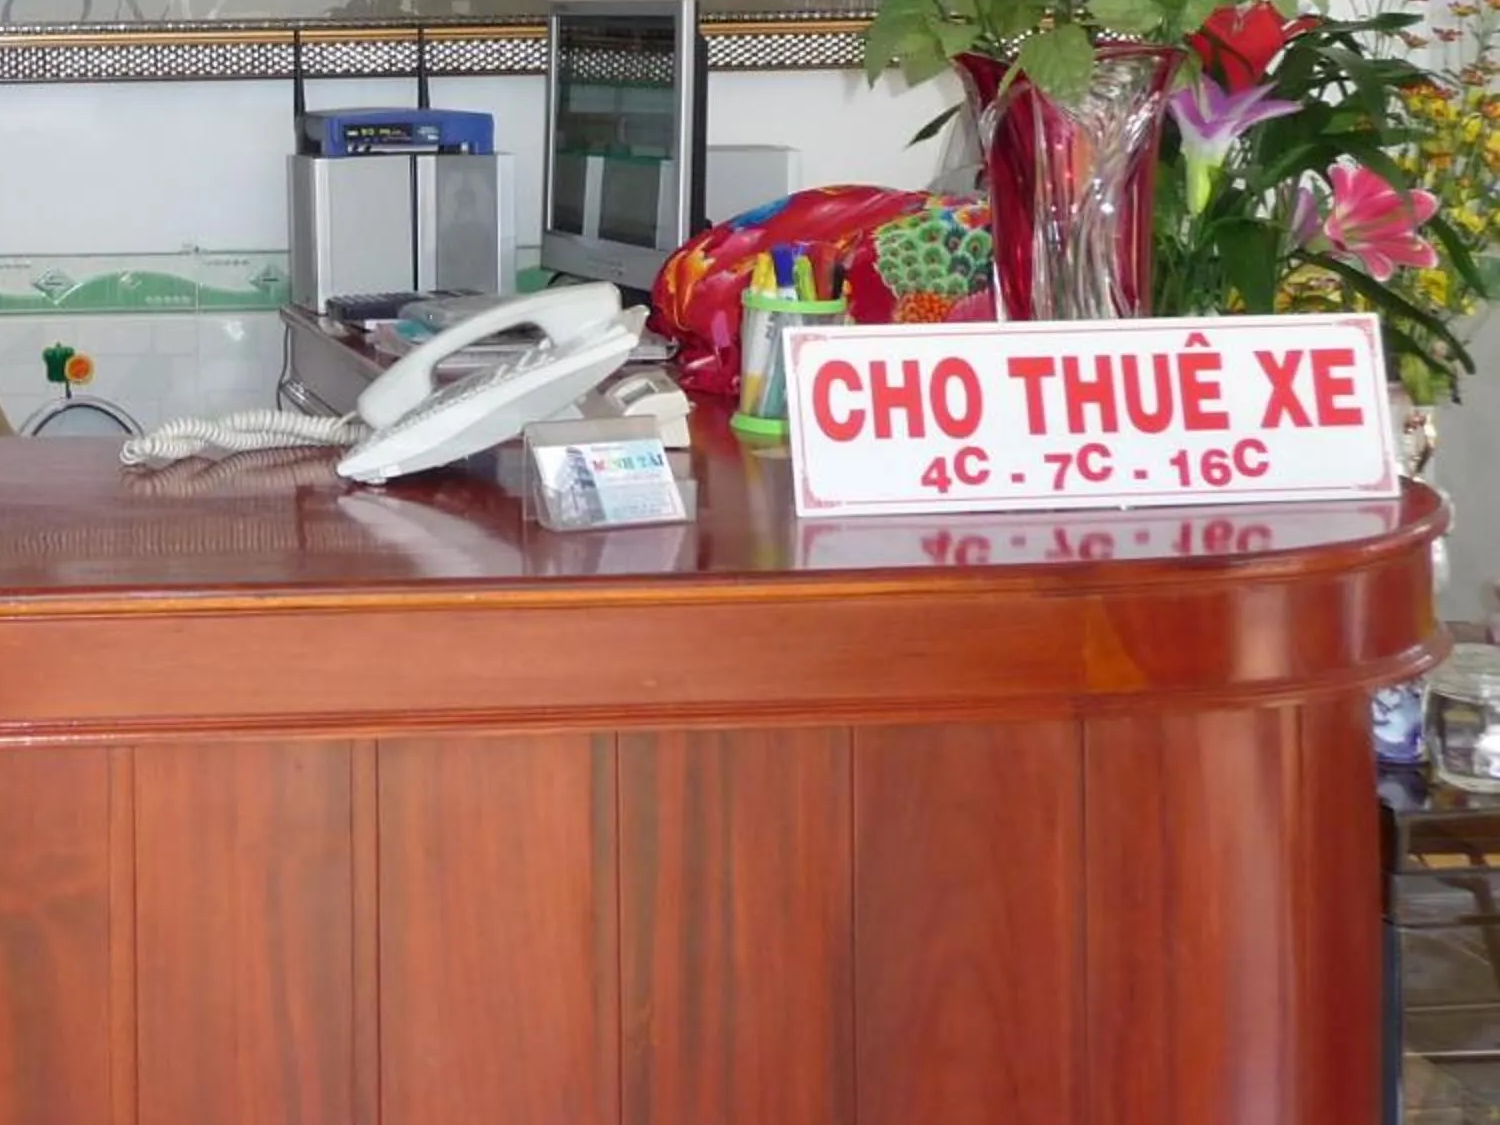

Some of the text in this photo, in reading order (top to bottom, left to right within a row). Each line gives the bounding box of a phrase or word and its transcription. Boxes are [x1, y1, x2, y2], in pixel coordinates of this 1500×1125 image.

[812, 332, 1365, 442] CHO THUÊ XE
[920, 445, 991, 494] 4C
[1043, 442, 1114, 491] 7C
[1169, 437, 1271, 488] 16C
